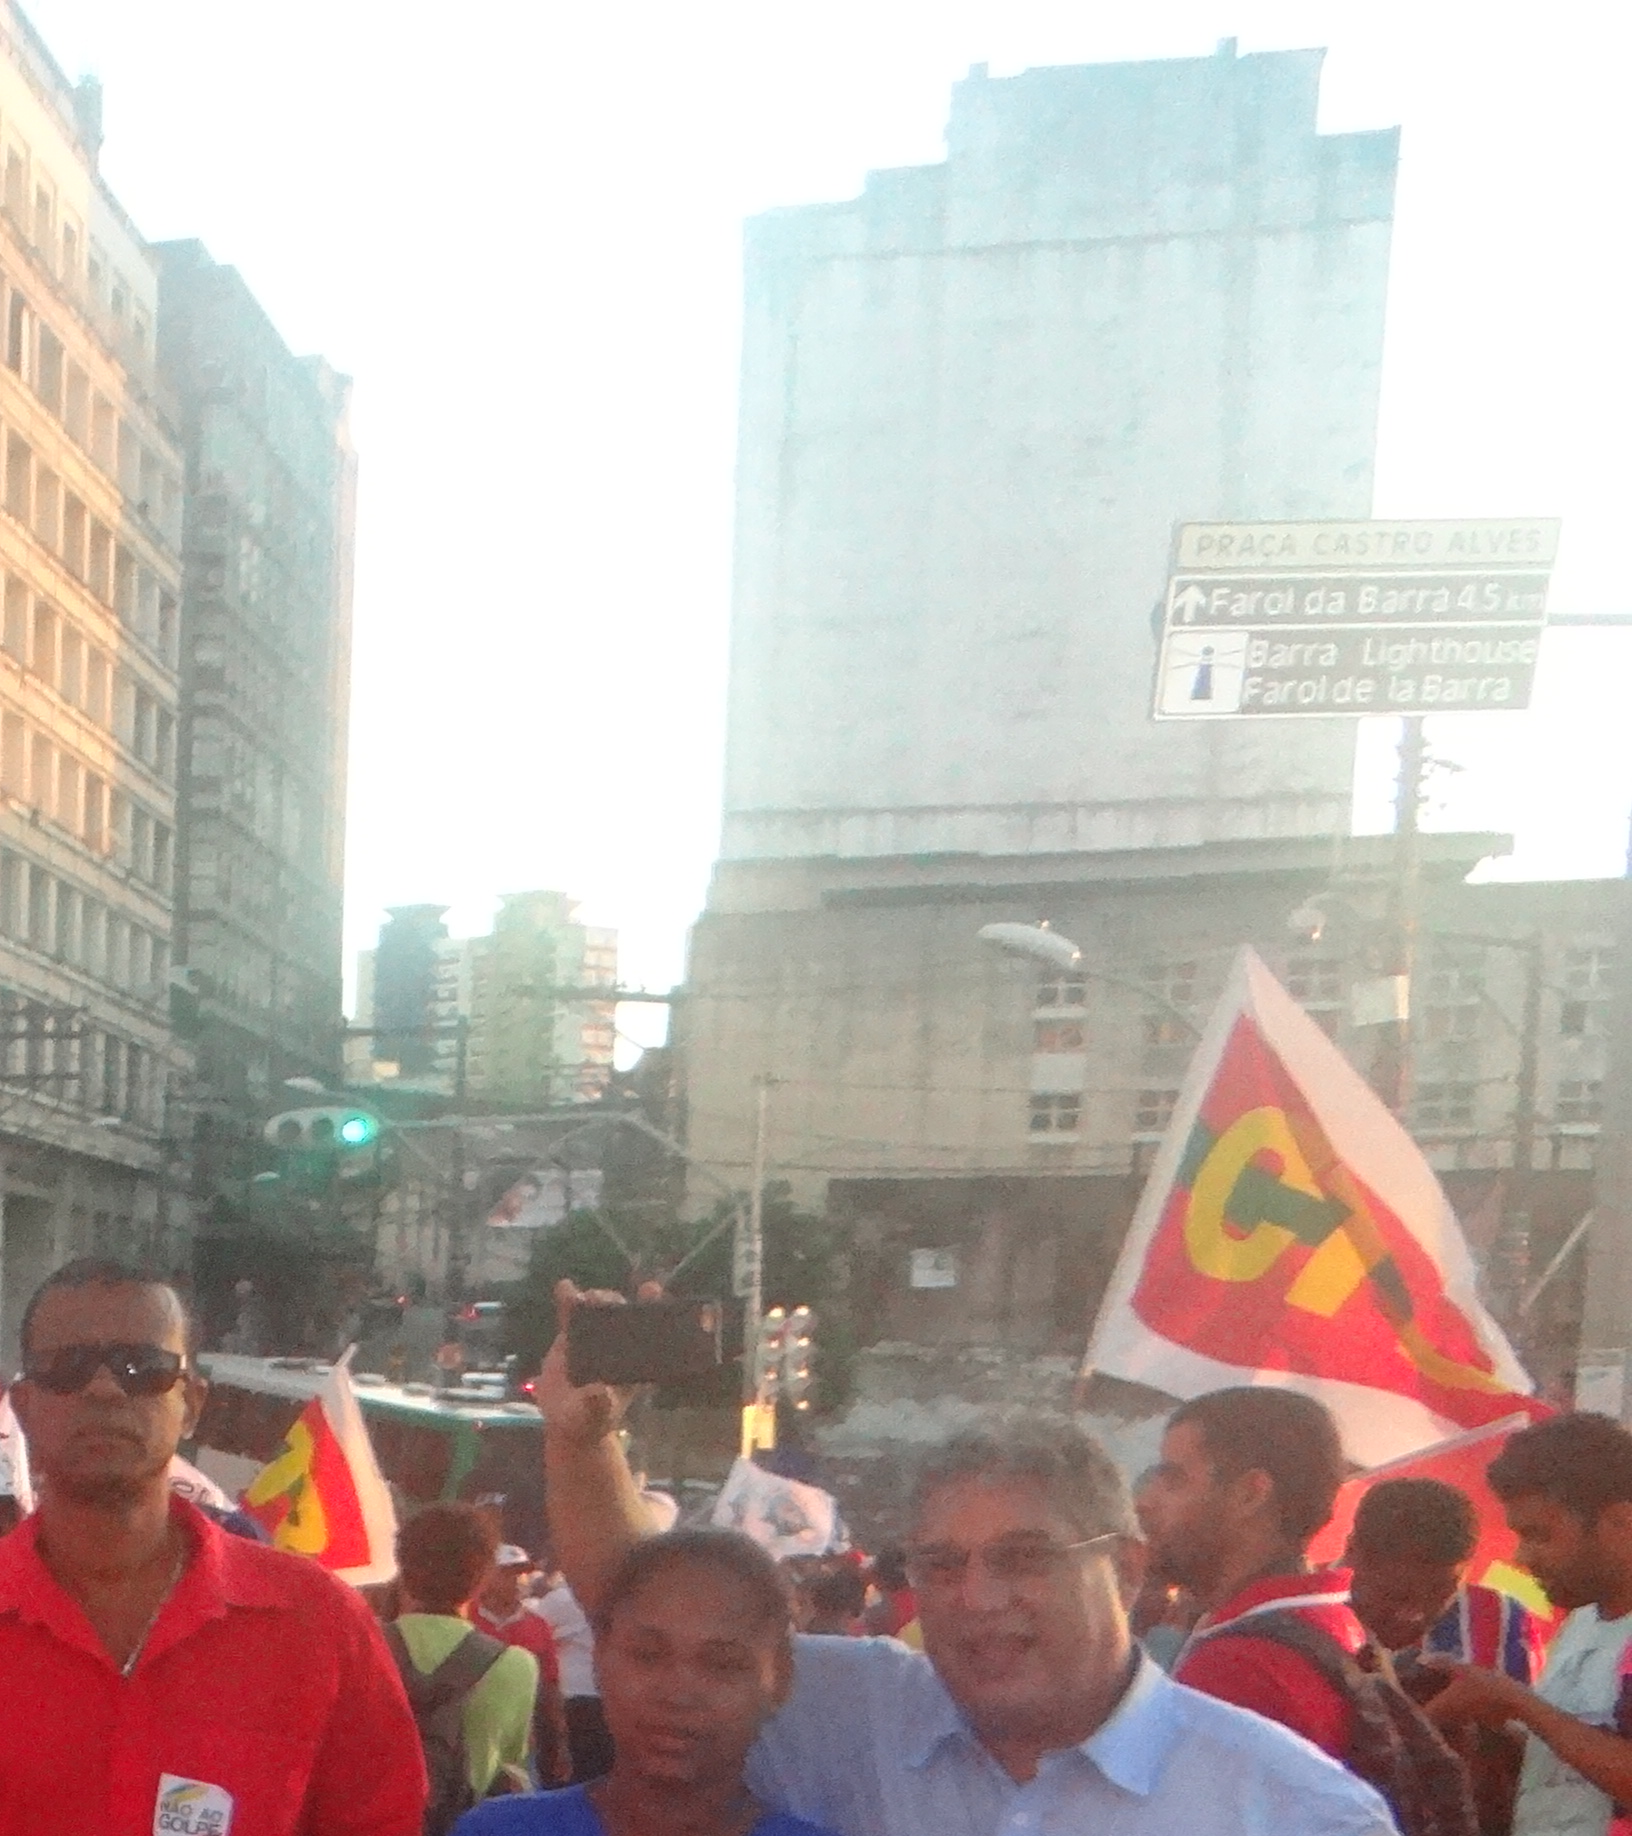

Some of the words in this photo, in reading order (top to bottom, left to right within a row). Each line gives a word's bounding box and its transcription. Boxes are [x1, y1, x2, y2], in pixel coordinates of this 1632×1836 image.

[1311, 530, 1434, 557] CASTRO
[1445, 528, 1544, 555] ALVES
[1207, 586, 1295, 616] Farol
[1303, 585, 1348, 616] da
[1356, 585, 1451, 615] Barra
[1248, 638, 1339, 669] Barra
[1361, 636, 1536, 672] Lighthouse
[1242, 675, 1334, 706] Farol
[1334, 674, 1377, 704] de
[1388, 673, 1422, 704] la
[1422, 674, 1514, 703] Barra
